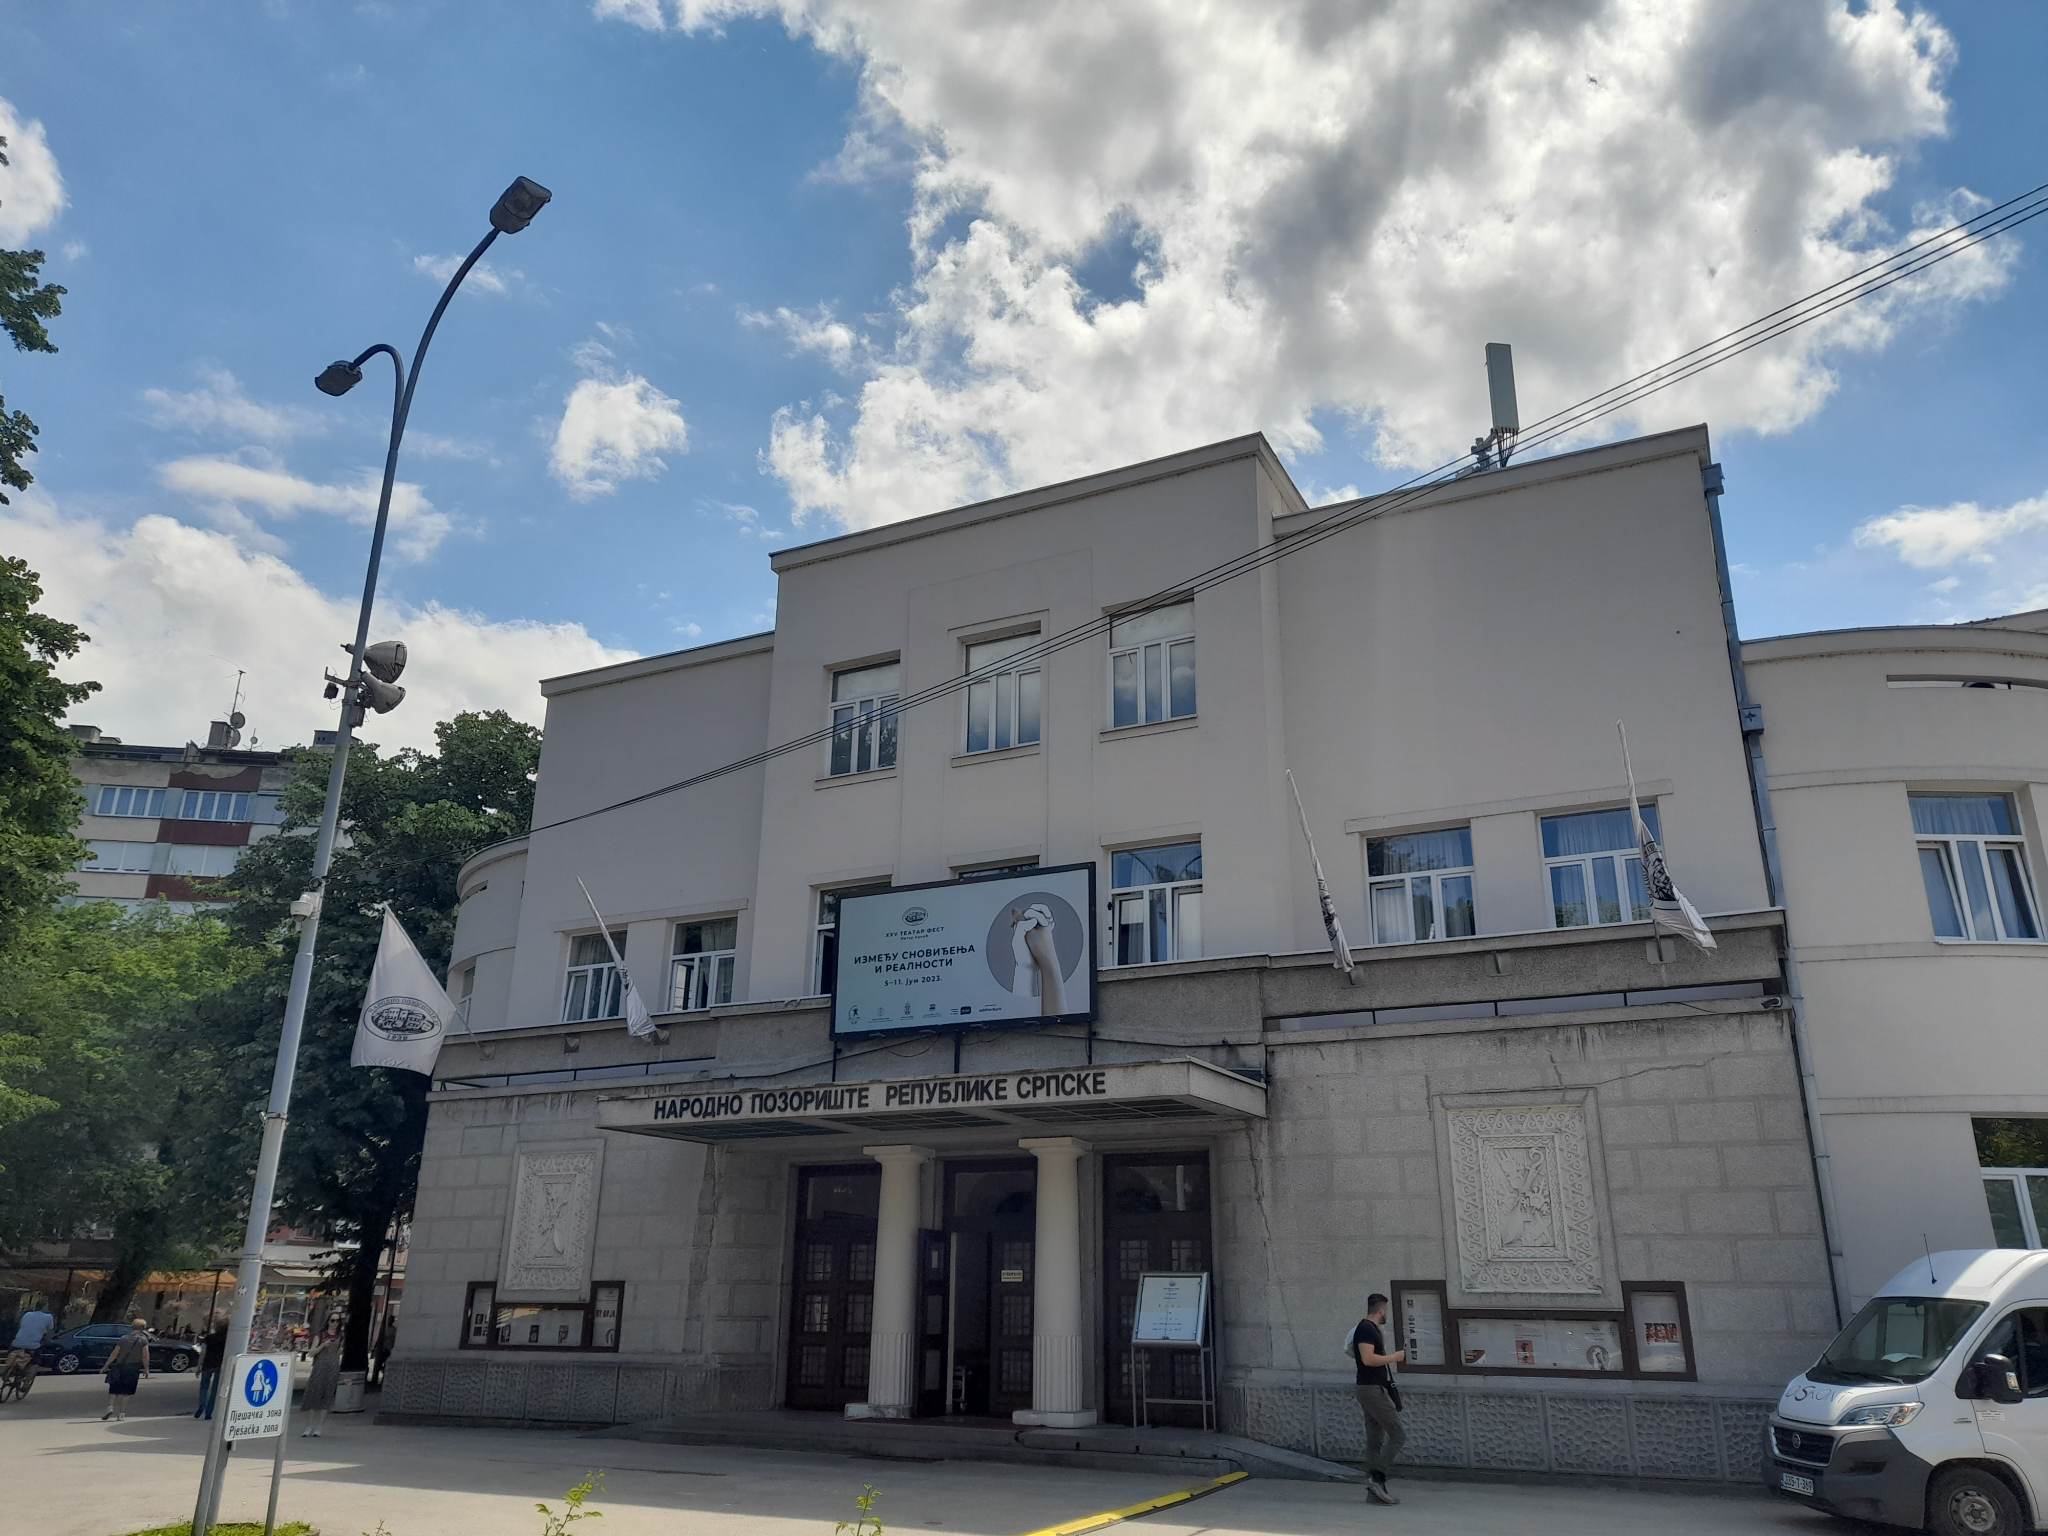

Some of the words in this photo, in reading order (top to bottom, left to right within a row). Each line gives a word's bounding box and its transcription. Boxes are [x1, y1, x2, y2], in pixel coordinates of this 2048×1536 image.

[900, 928, 925, 937] ТЕАТАР
[926, 926, 945, 934] ФЕСТ
[854, 952, 899, 965] ИЗМЕЂУ
[901, 944, 976, 960] СНОВИЂЕЊА
[875, 965, 882, 974] И
[885, 958, 953, 973] РЕАЛНОСТИ
[653, 1094, 743, 1120] НАРОДНО
[750, 1087, 870, 1114] ПОЗОРИШТЕ
[885, 1078, 1008, 1107] РЕПУБЛИКЕ
[1016, 1071, 1106, 1099] СРПСКЕ
[230, 1410, 263, 1424] Пјешачка
[266, 1409, 282, 1418] зона
[263, 1424, 279, 1433] zona
